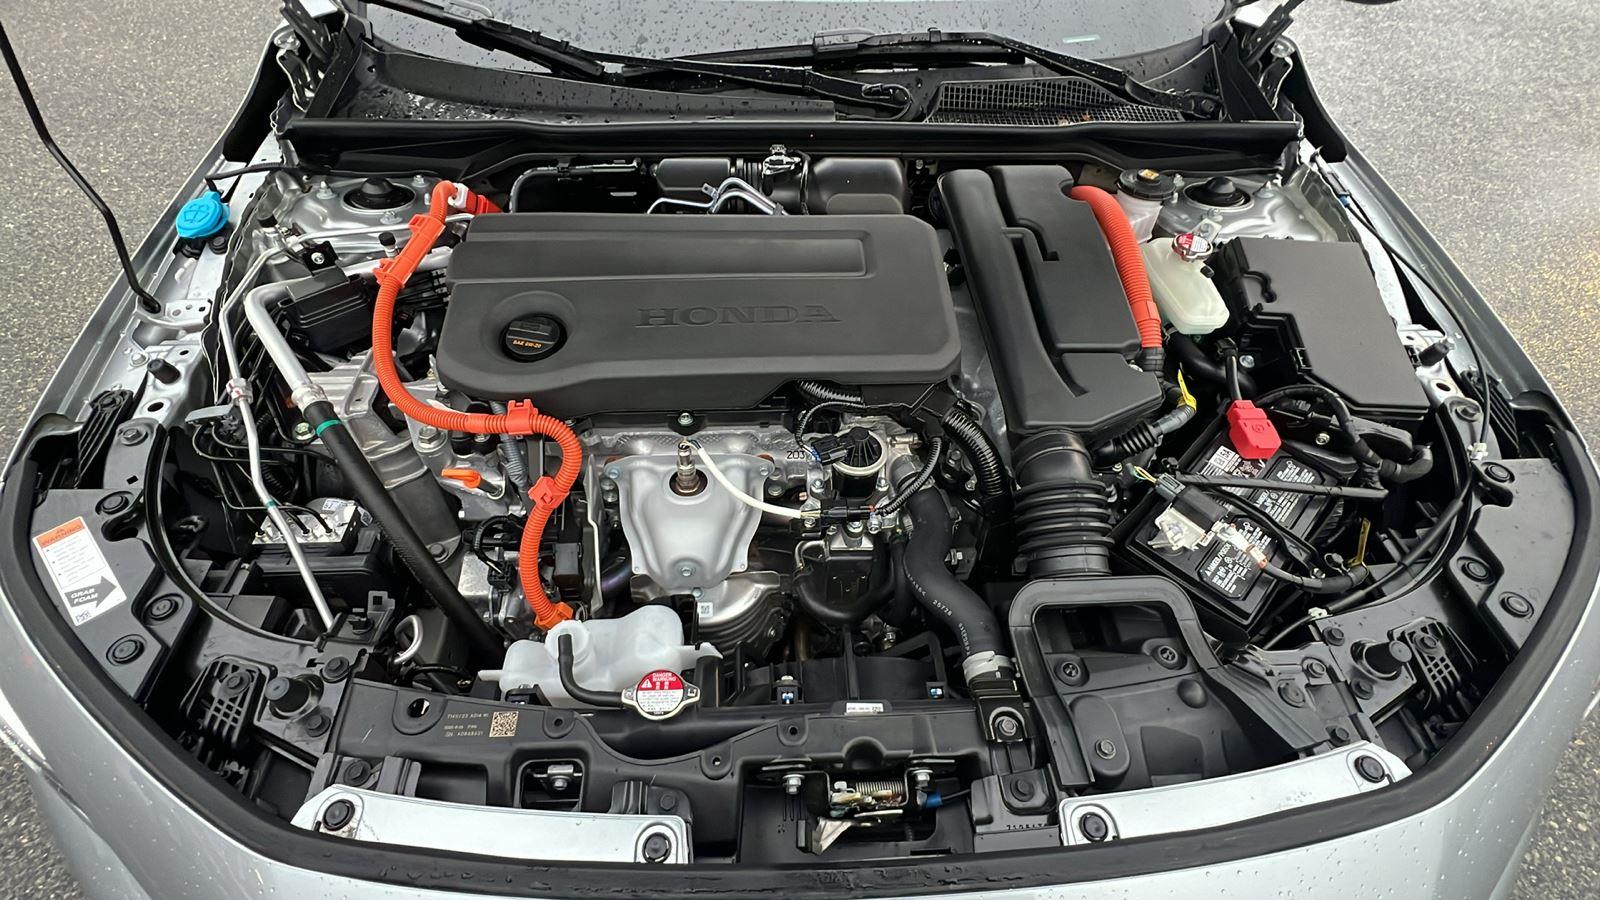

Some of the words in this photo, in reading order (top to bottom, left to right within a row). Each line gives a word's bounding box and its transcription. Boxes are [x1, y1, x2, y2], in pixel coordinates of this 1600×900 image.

[635, 305, 841, 327] HONDA
[787, 450, 805, 459] 203
[70, 588, 95, 599] GRAB
[73, 593, 98, 604] FOAM
